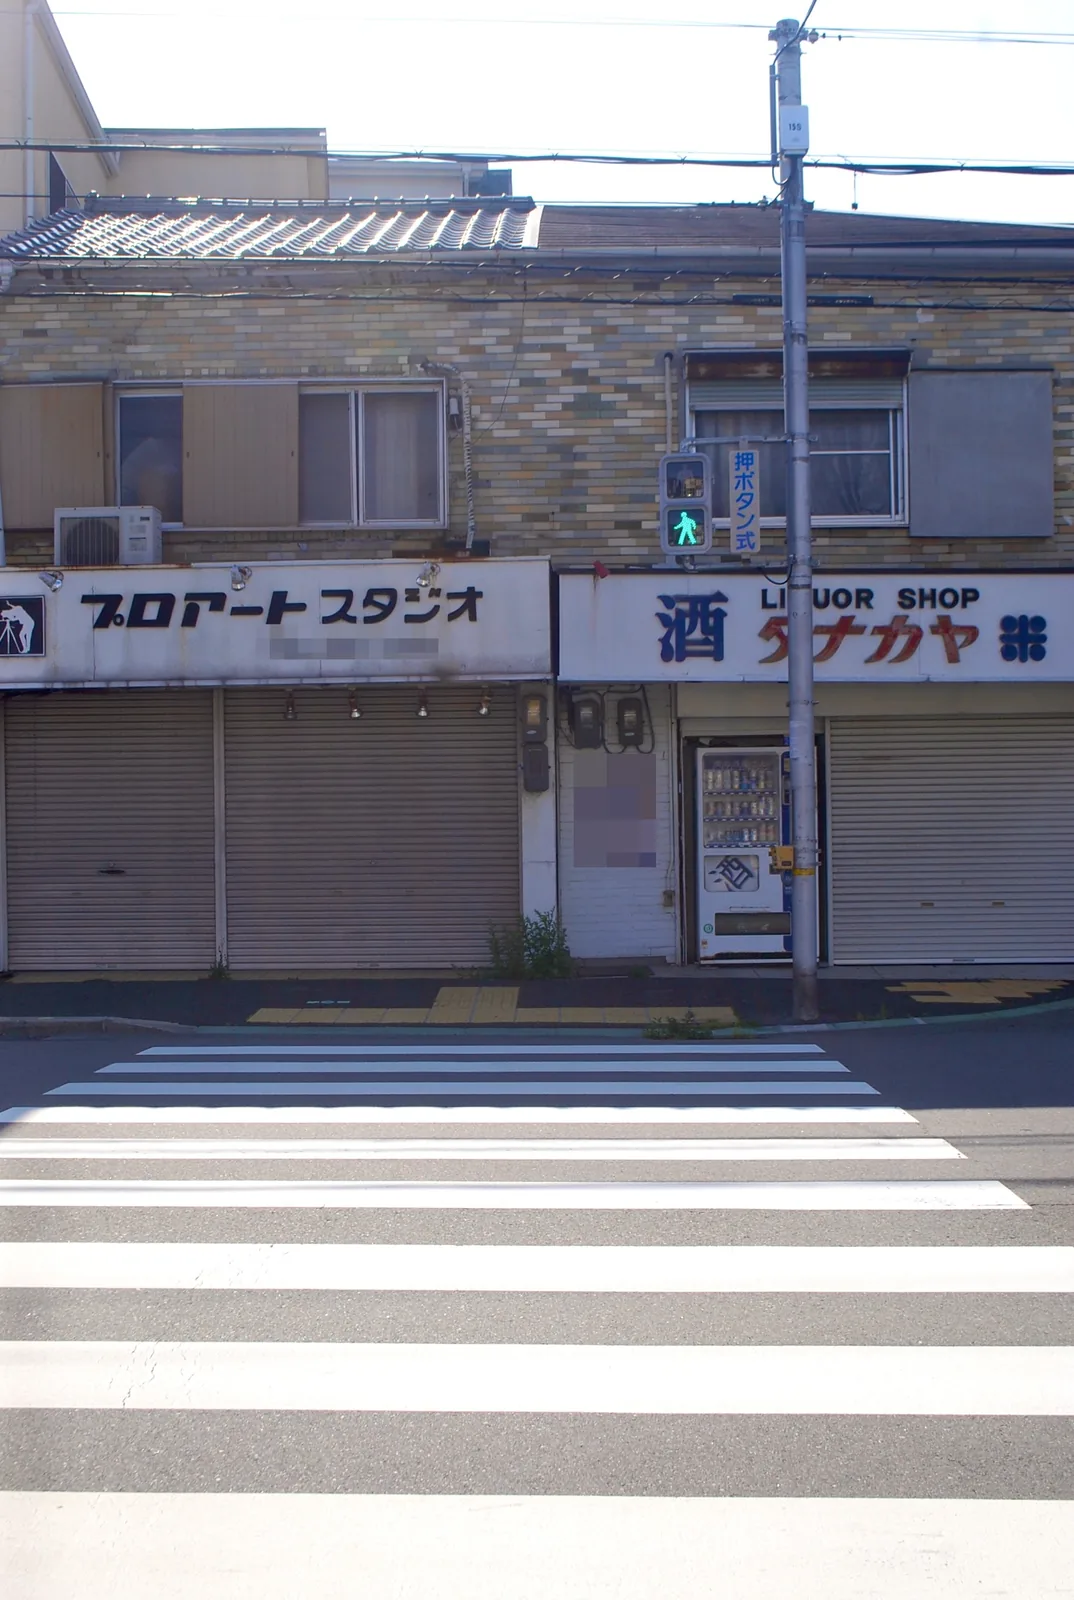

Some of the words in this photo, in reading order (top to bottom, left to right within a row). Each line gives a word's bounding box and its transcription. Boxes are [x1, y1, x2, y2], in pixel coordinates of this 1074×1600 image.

[734, 451, 756, 550] 押ボタン式
[80, 586, 483, 628] プロアートスタジオ
[655, 590, 729, 663] 酒
[761, 587, 874, 609] LIUOR
[896, 587, 980, 610] SHOP
